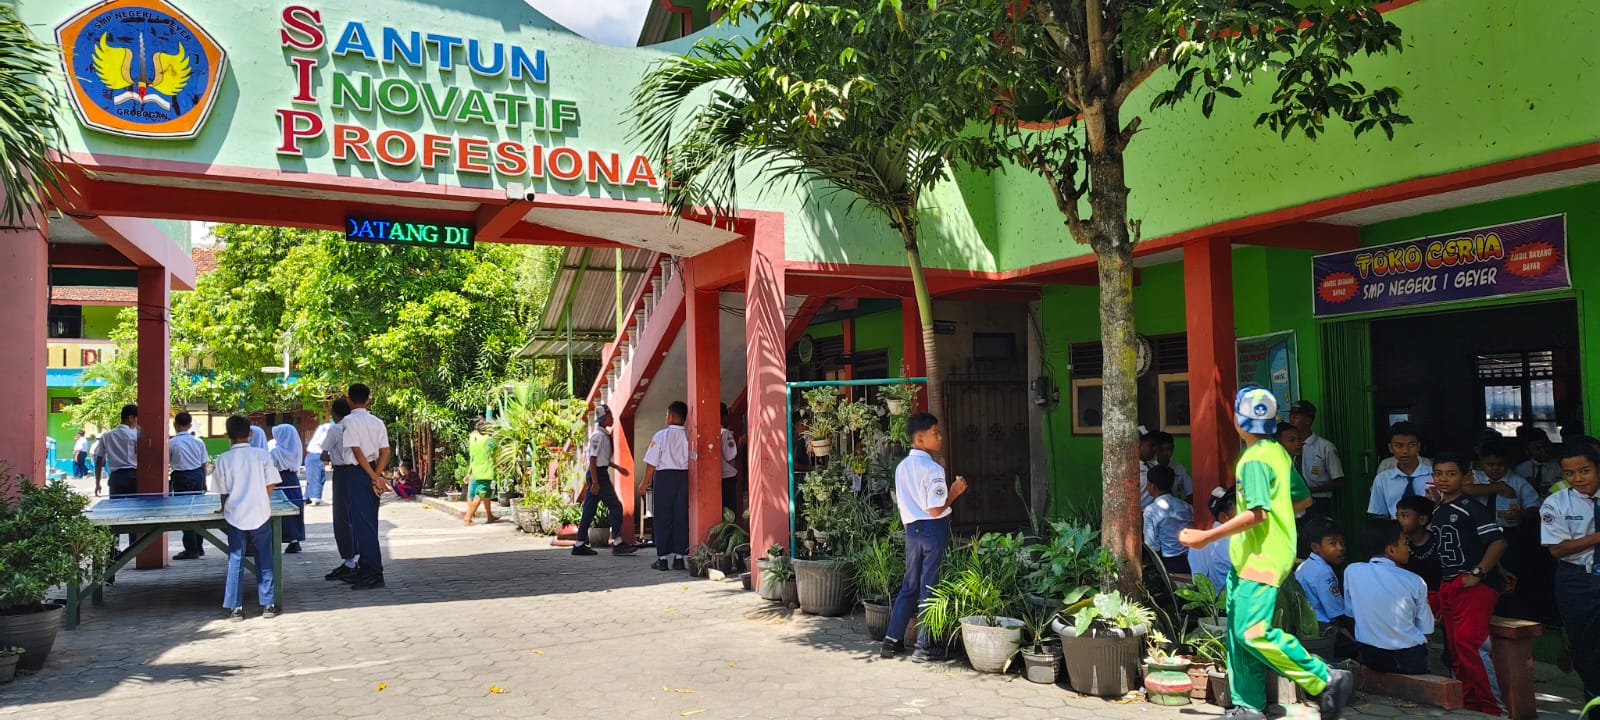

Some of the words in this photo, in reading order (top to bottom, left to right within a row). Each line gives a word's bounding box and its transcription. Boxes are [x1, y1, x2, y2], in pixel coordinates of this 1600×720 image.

[117, 108, 168, 120] GROBOGAN
[444, 226, 470, 246] DI
[1355, 246, 1422, 279] TOKO
[1425, 232, 1505, 269] CERIA
[1363, 284, 1383, 300] SMP
[1388, 274, 1437, 298] NEGERI
[1453, 267, 1498, 289] GEYER
